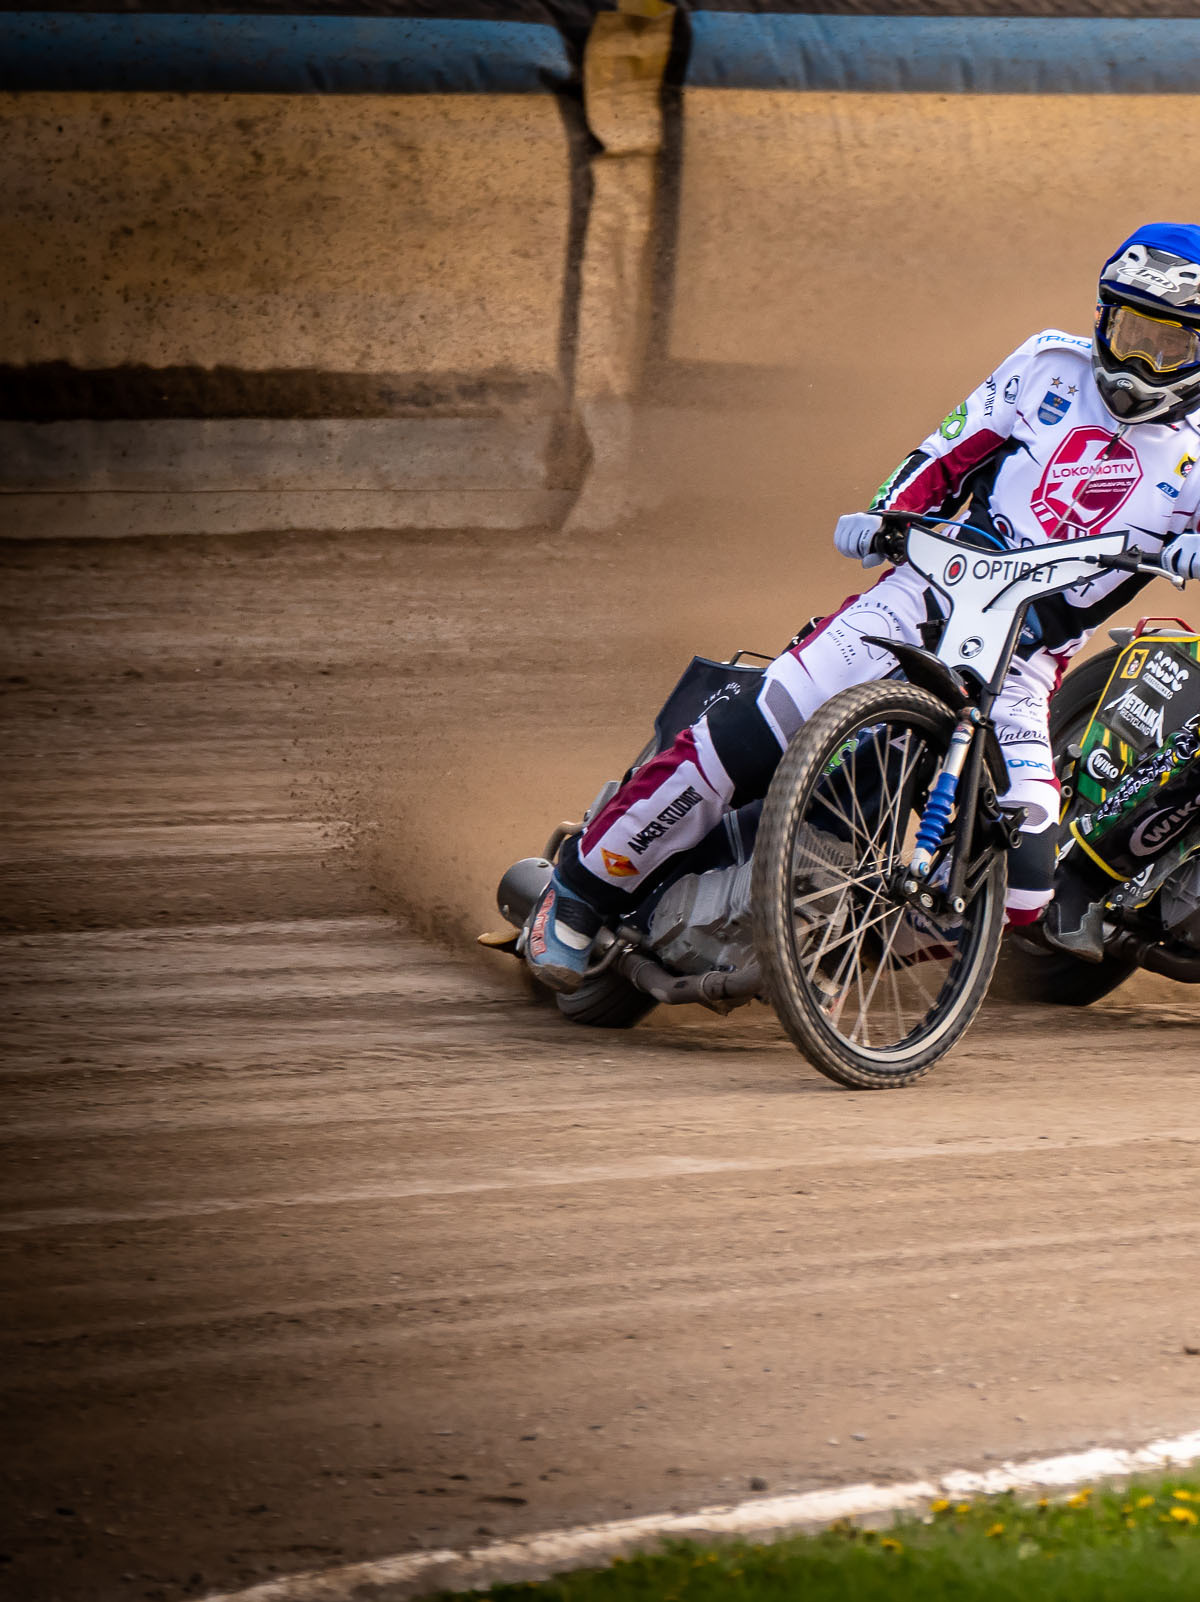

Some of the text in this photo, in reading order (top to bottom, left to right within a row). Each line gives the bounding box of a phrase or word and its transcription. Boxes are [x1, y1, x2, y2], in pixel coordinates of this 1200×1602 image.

[1052, 463, 1135, 479] LOKOMOTIV
[972, 559, 1058, 584] OPTIBET
[1119, 707, 1152, 737] RECYCLING
[1093, 754, 1119, 779] WIKO
[659, 786, 704, 827] STUDIOS
